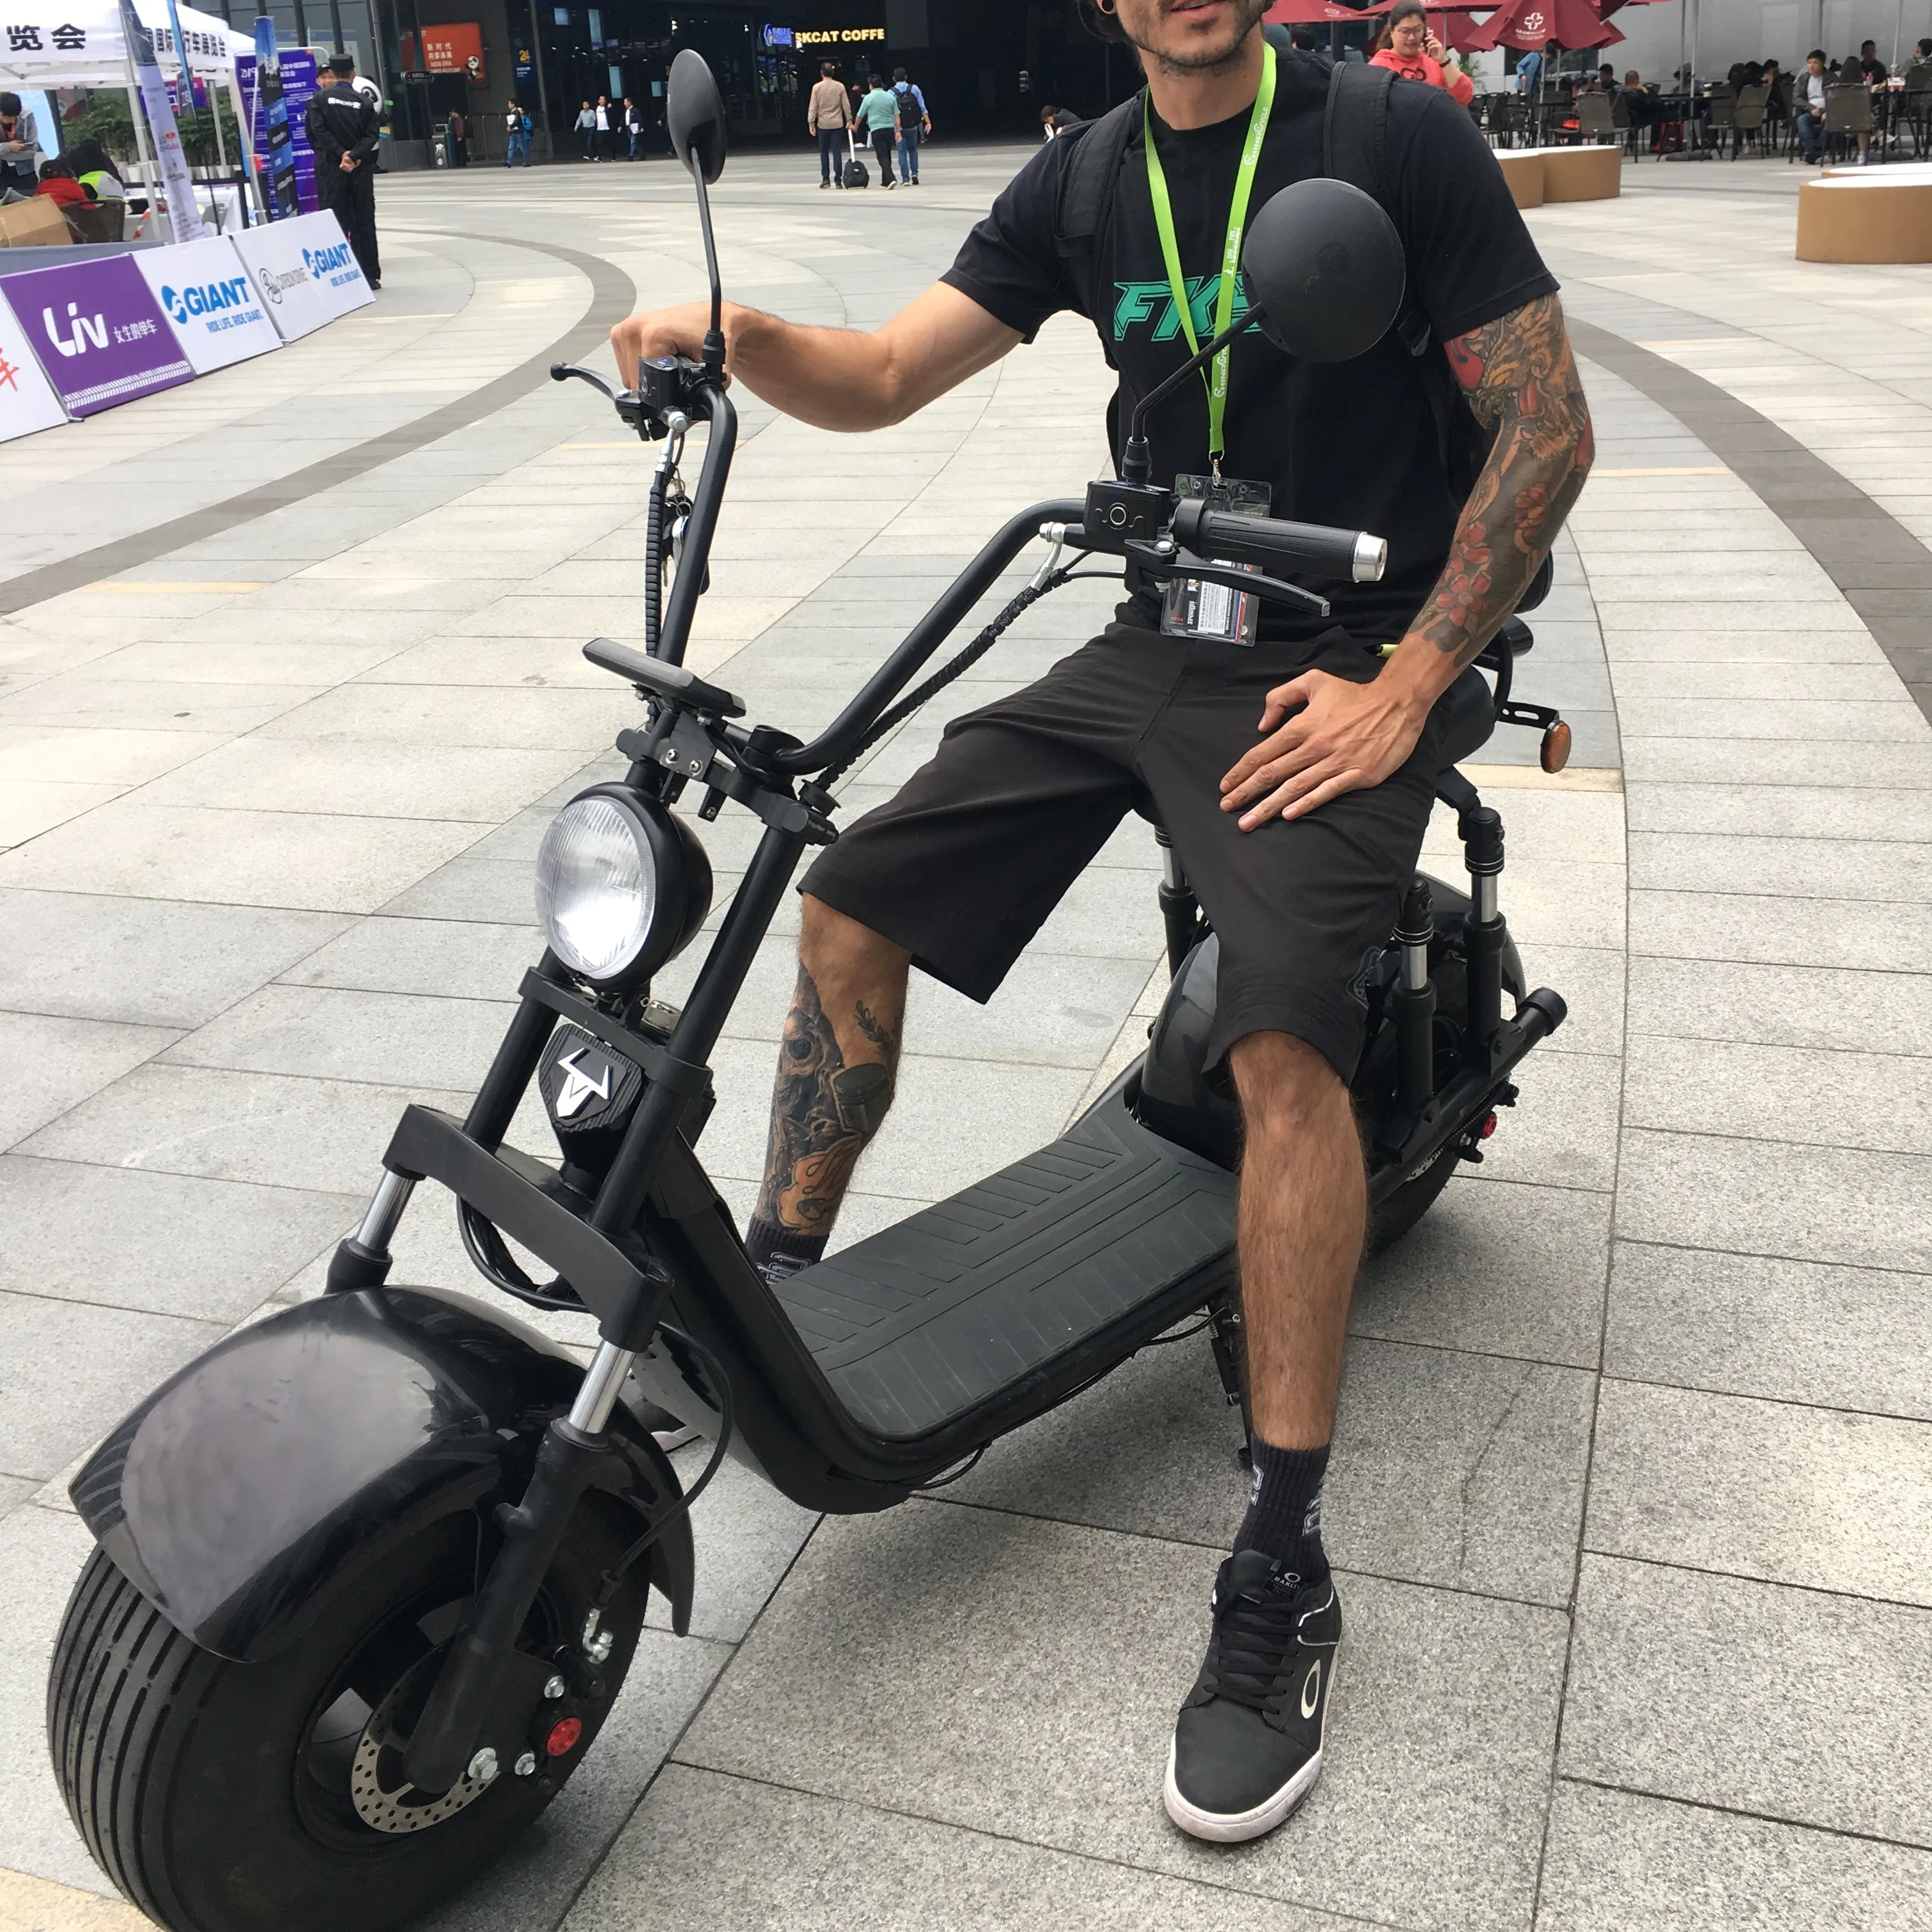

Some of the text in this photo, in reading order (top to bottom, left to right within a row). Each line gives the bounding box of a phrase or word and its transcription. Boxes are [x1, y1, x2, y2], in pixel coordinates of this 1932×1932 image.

[6, 23, 86, 52] 览会
[841, 28, 885, 41] COFFE
[314, 242, 352, 274] GIANT
[183, 277, 250, 316] GIANT
